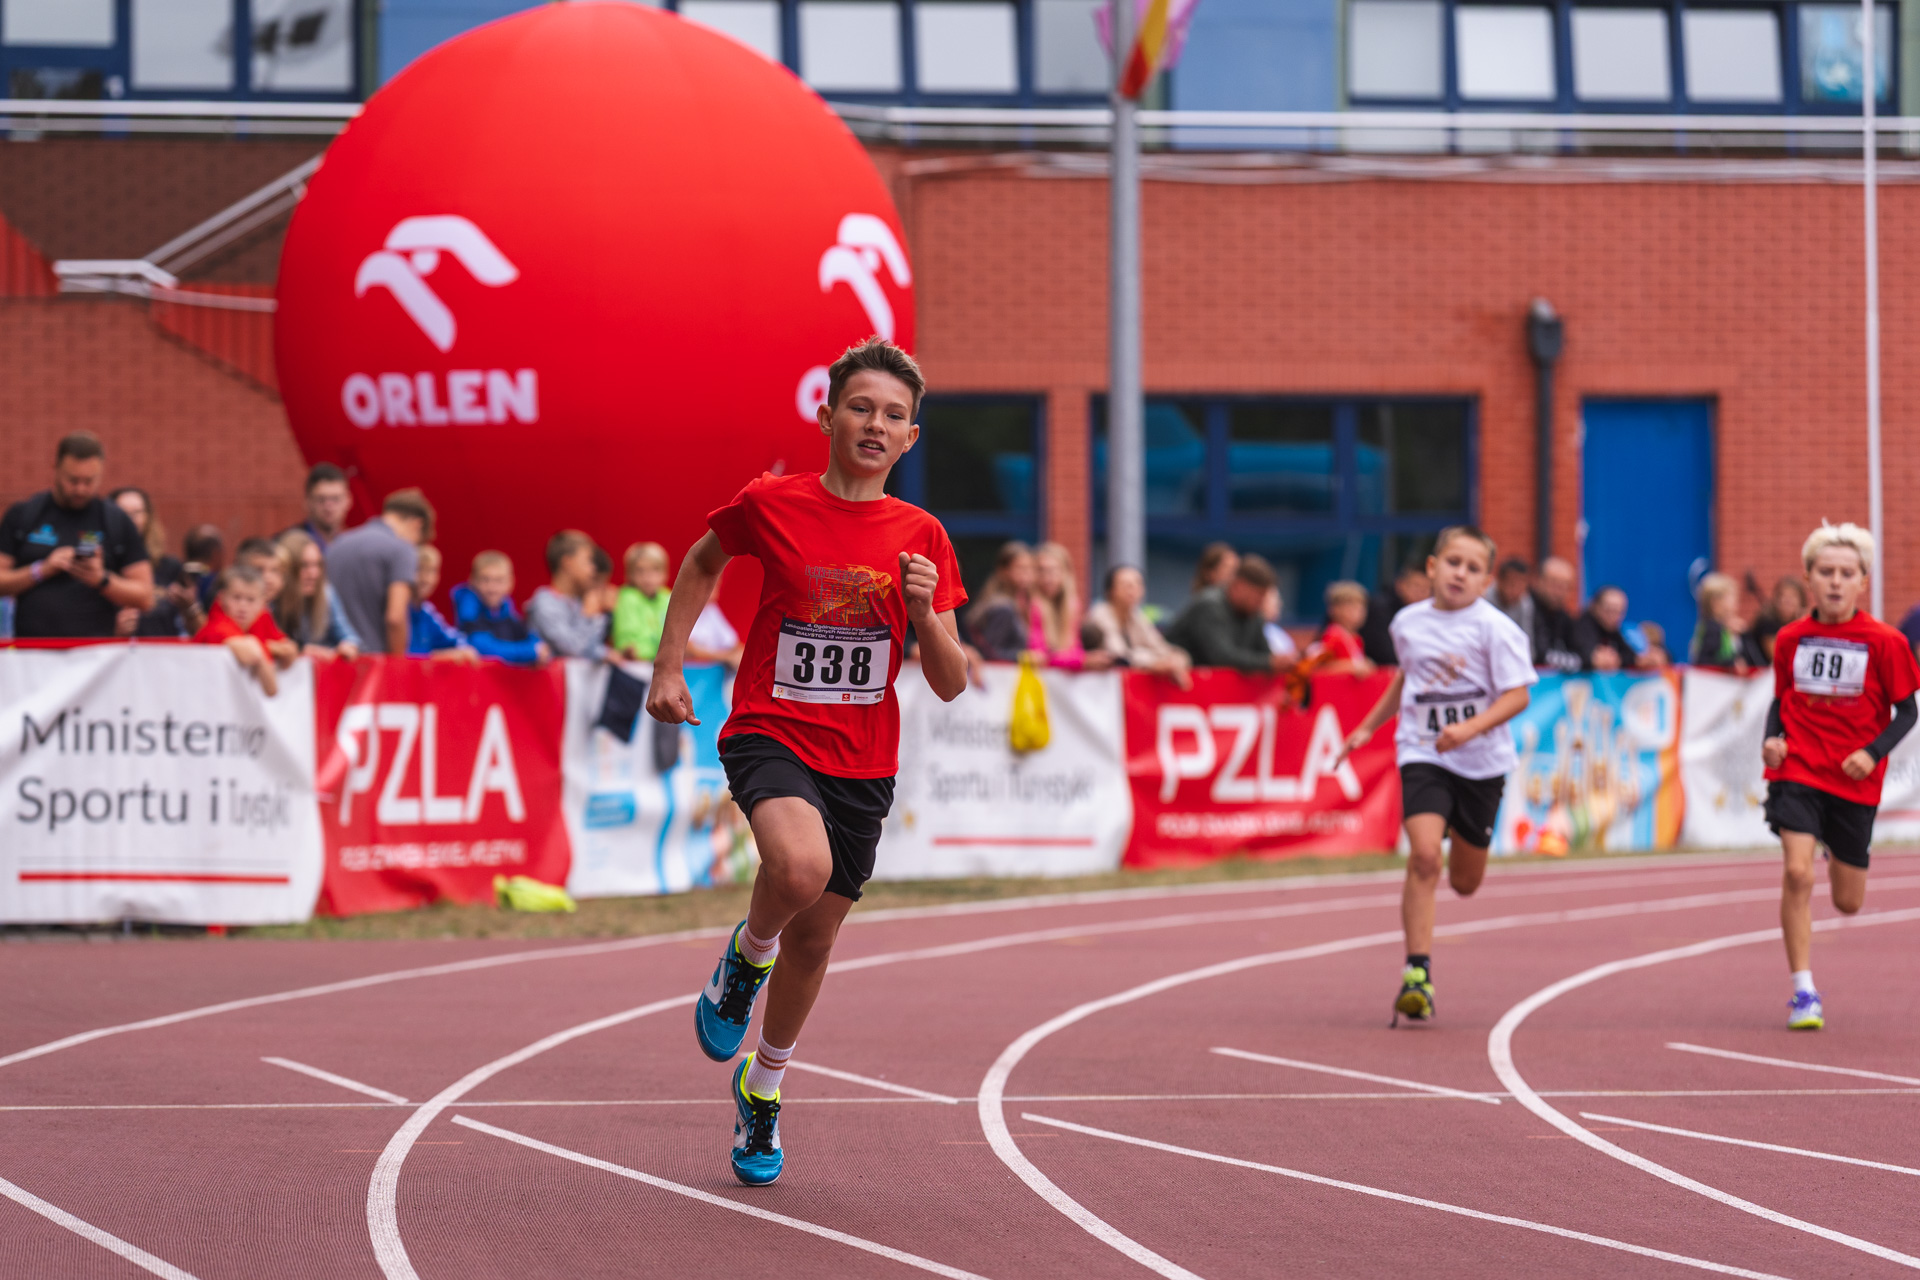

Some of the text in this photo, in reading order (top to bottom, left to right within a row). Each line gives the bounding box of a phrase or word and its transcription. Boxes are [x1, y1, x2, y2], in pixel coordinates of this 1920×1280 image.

[340, 368, 539, 430] ORLEN
[793, 642, 872, 685] 338
[1812, 652, 1843, 679] 69
[337, 702, 526, 826] PZLA
[1156, 703, 1362, 804] PZLA
[16, 775, 188, 835] Sportu
